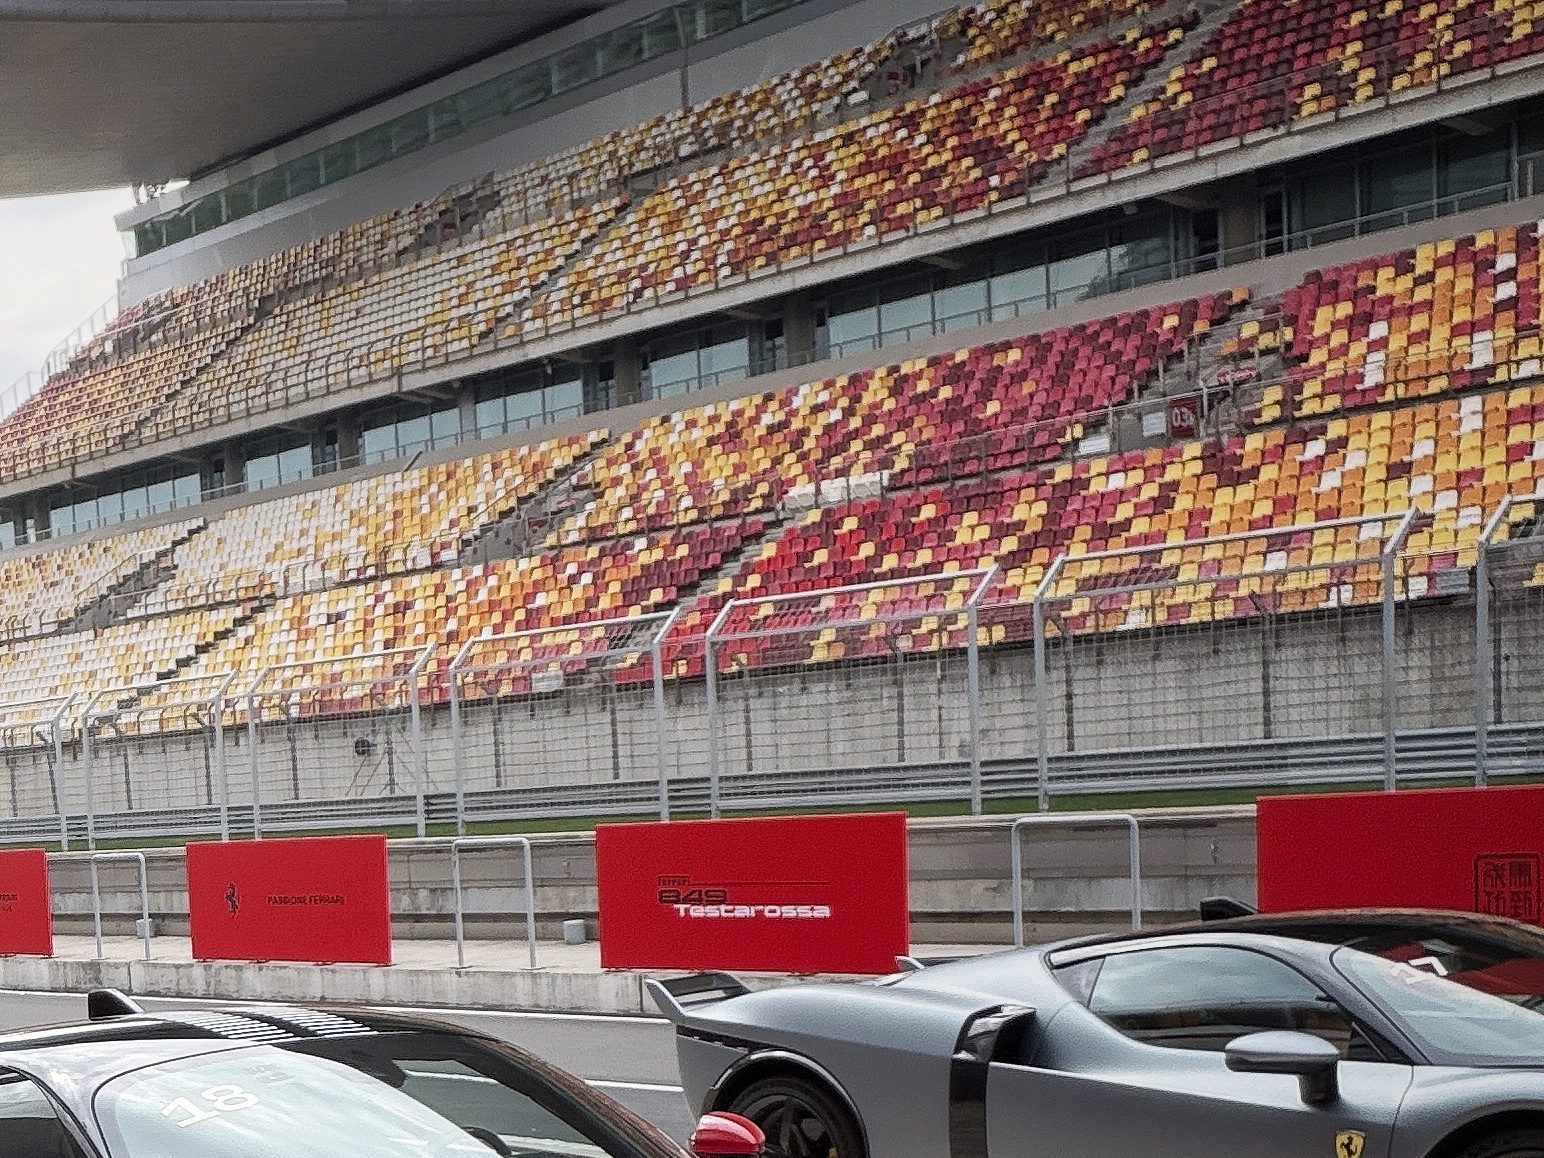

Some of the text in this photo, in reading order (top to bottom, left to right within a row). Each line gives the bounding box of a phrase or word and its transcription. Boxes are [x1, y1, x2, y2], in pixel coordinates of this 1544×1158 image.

[658, 888, 727, 904] 849
[673, 903, 832, 919] Testarossa
[1390, 956, 1448, 985] 17
[161, 1084, 259, 1128] 18
